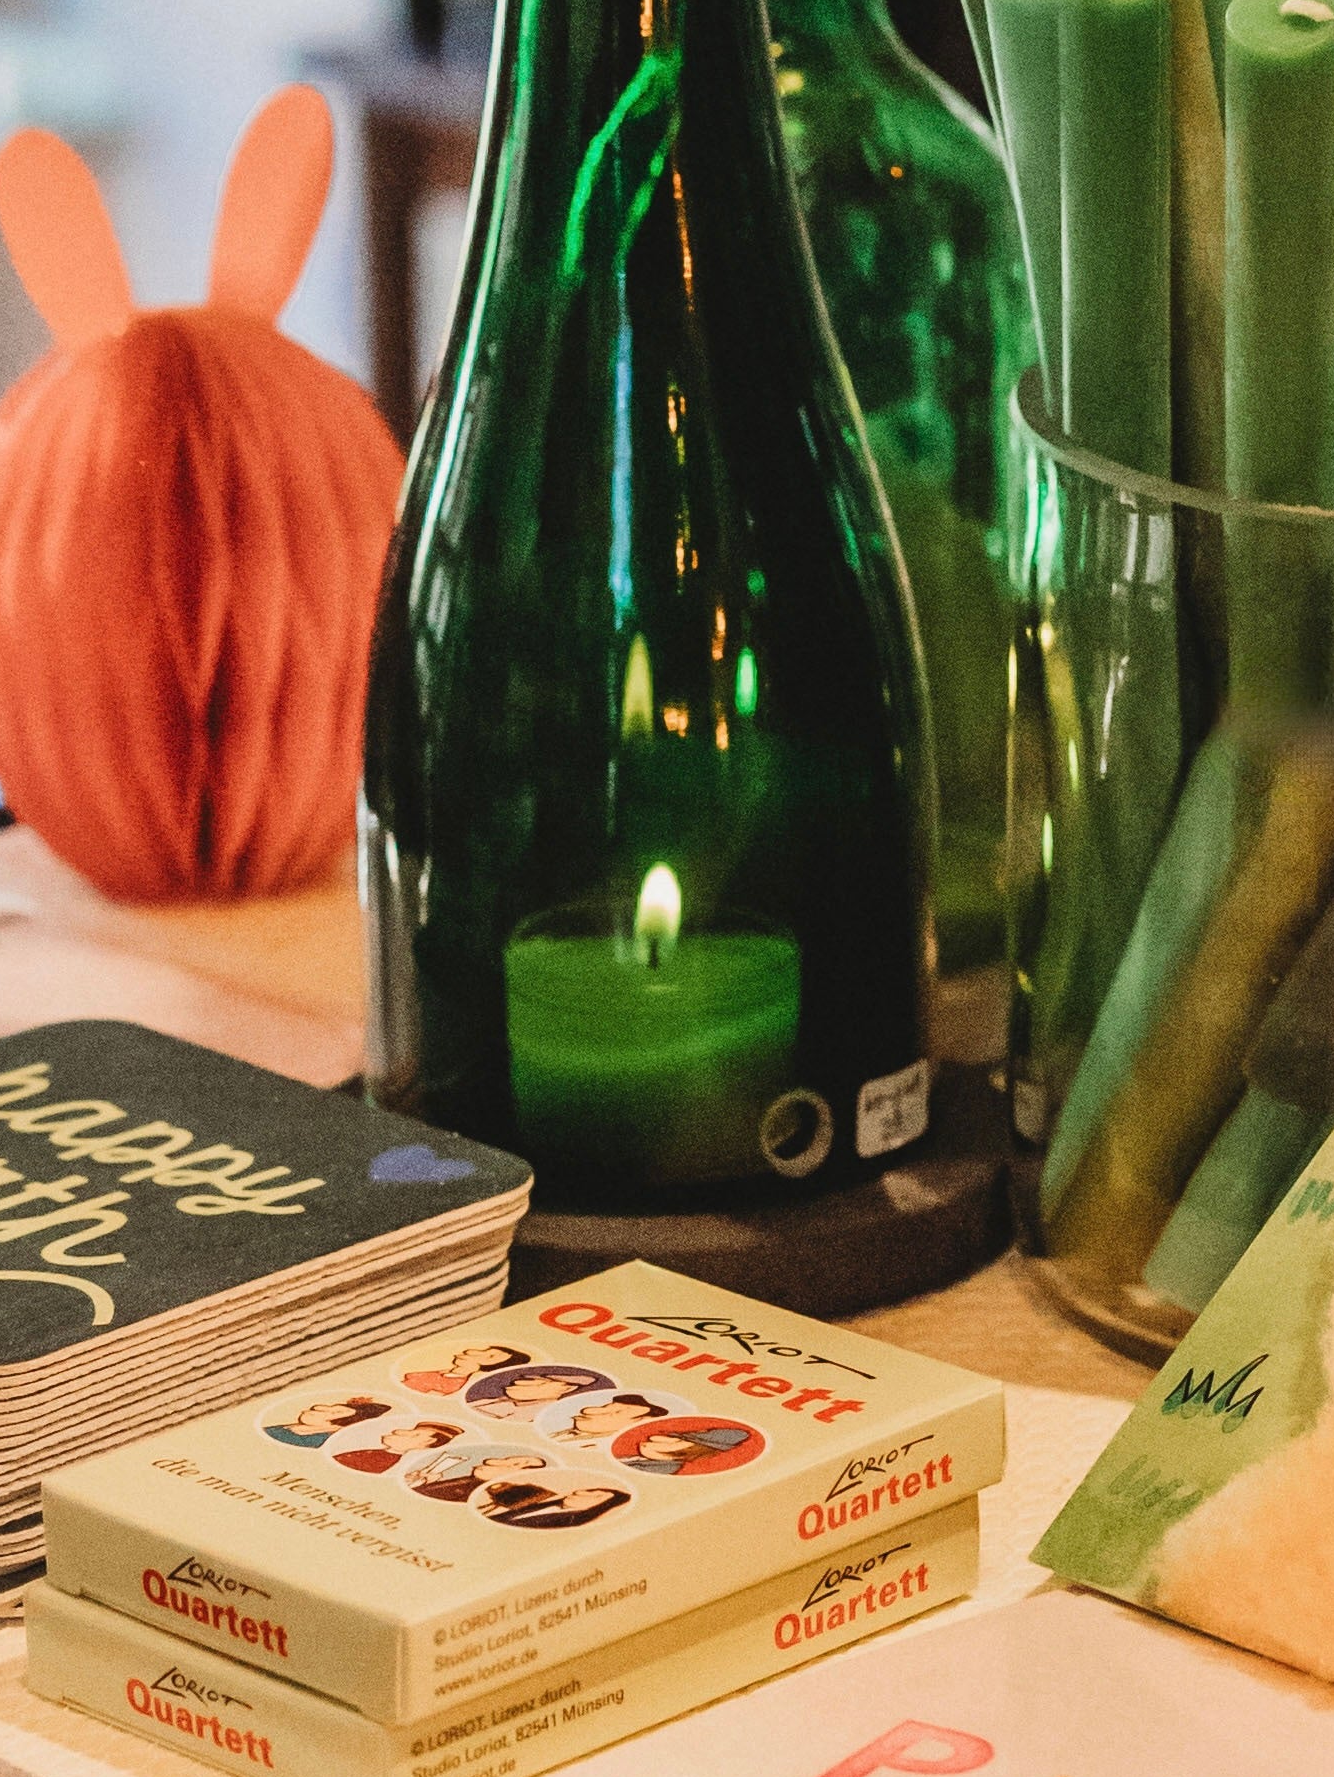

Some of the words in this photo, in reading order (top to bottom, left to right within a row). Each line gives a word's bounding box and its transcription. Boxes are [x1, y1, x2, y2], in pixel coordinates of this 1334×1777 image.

[538, 1302, 867, 1424] Quartett
[625, 1315, 877, 1380] LORIOT
[259, 1470, 403, 1530] Menschen,
[797, 1453, 954, 1541] Quartett
[825, 1434, 935, 1503] LORIOT
[150, 1456, 201, 1478] die
[195, 1474, 266, 1504] man
[261, 1497, 343, 1531] nicht
[335, 1523, 454, 1573] vergisst
[166, 1555, 272, 1600] LORIOT
[514, 1586, 559, 1615] Lizenz
[562, 1568, 605, 1596] durch
[773, 1562, 929, 1650] Quartett
[801, 1542, 912, 1613] LORIOT
[141, 1568, 289, 1658] Quartett
[434, 1642, 483, 1672] Studio
[537, 1602, 581, 1633] 82541
[149, 1666, 254, 1710] LORIOT
[434, 1648, 539, 1698] www.loriot.de
[490, 1696, 536, 1726] Lizenz
[539, 1678, 582, 1707] durch
[125, 1677, 275, 1769] Quartett
[515, 1712, 558, 1743] 82541
